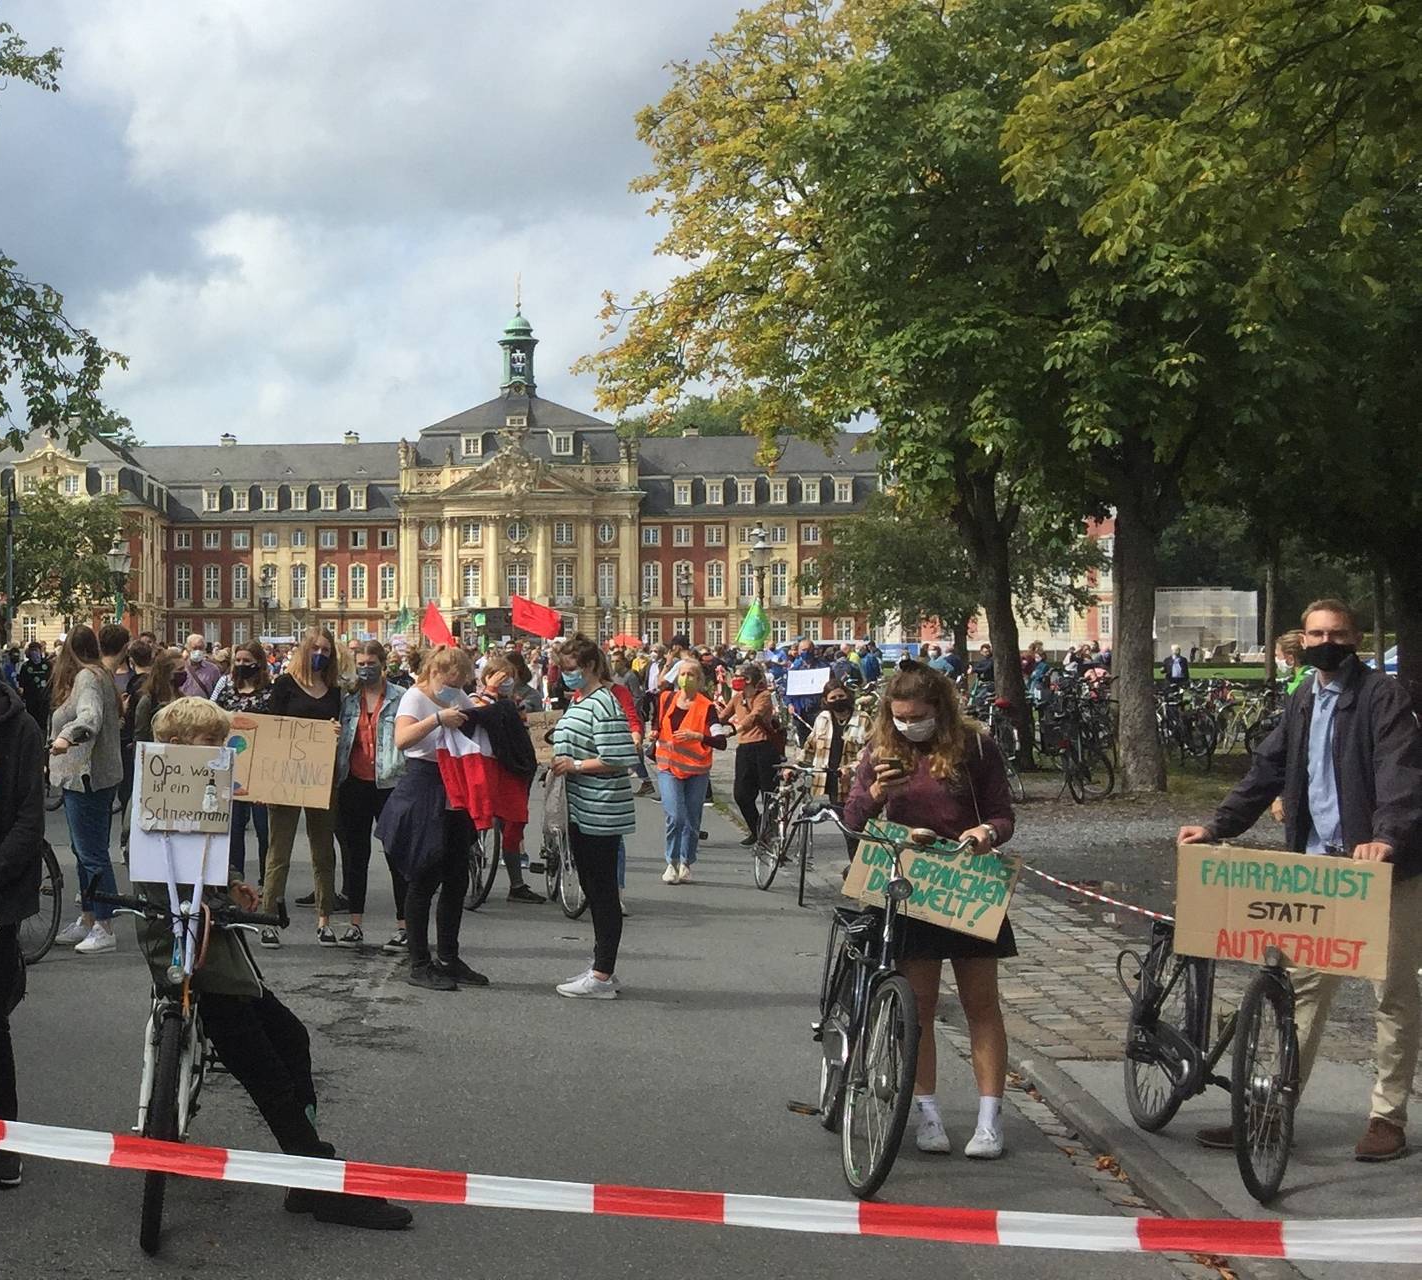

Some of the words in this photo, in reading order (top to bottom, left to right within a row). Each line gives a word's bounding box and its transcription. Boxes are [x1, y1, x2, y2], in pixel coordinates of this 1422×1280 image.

[274, 718, 328, 743] TIME
[289, 739, 307, 761] IS
[260, 758, 328, 786] RUNNING
[170, 783, 190, 793] ein
[144, 796, 229, 822] Schneemann
[908, 857, 1008, 907] BRAUCHEN
[1201, 859, 1375, 900] FAHRRADLUST
[907, 880, 990, 928] WELT!
[1247, 901, 1326, 925] STATT
